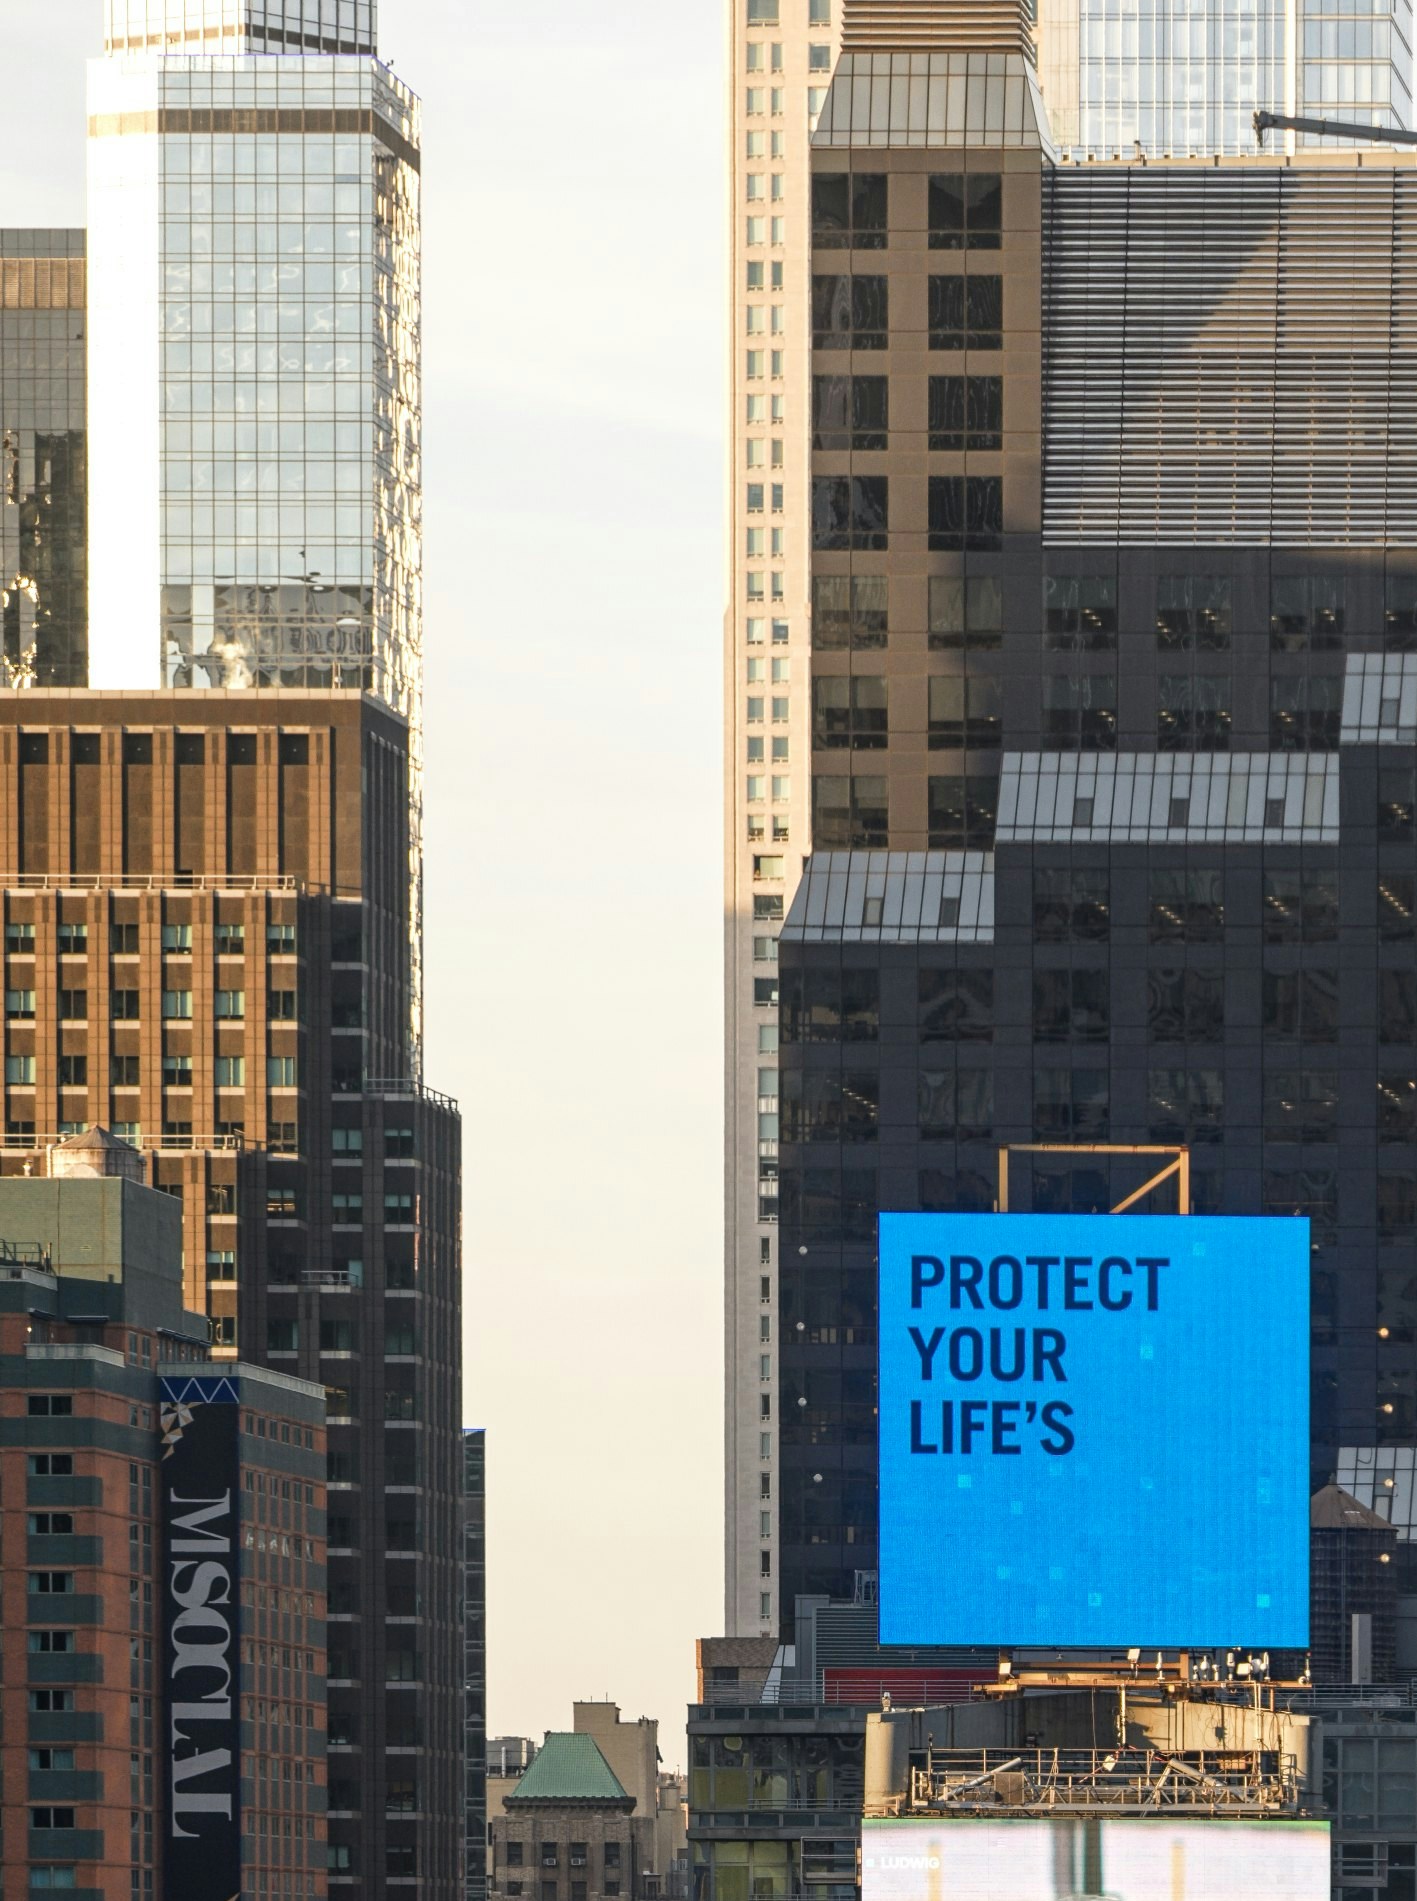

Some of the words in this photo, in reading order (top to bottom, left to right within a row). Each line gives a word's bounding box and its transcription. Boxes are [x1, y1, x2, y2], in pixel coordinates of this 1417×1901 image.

[911, 1255, 1170, 1311] PROTECT
[908, 1326, 1068, 1382] YOUR
[910, 1400, 1075, 1455] LIFE'S
[881, 1855, 939, 1869] LUDWIG
